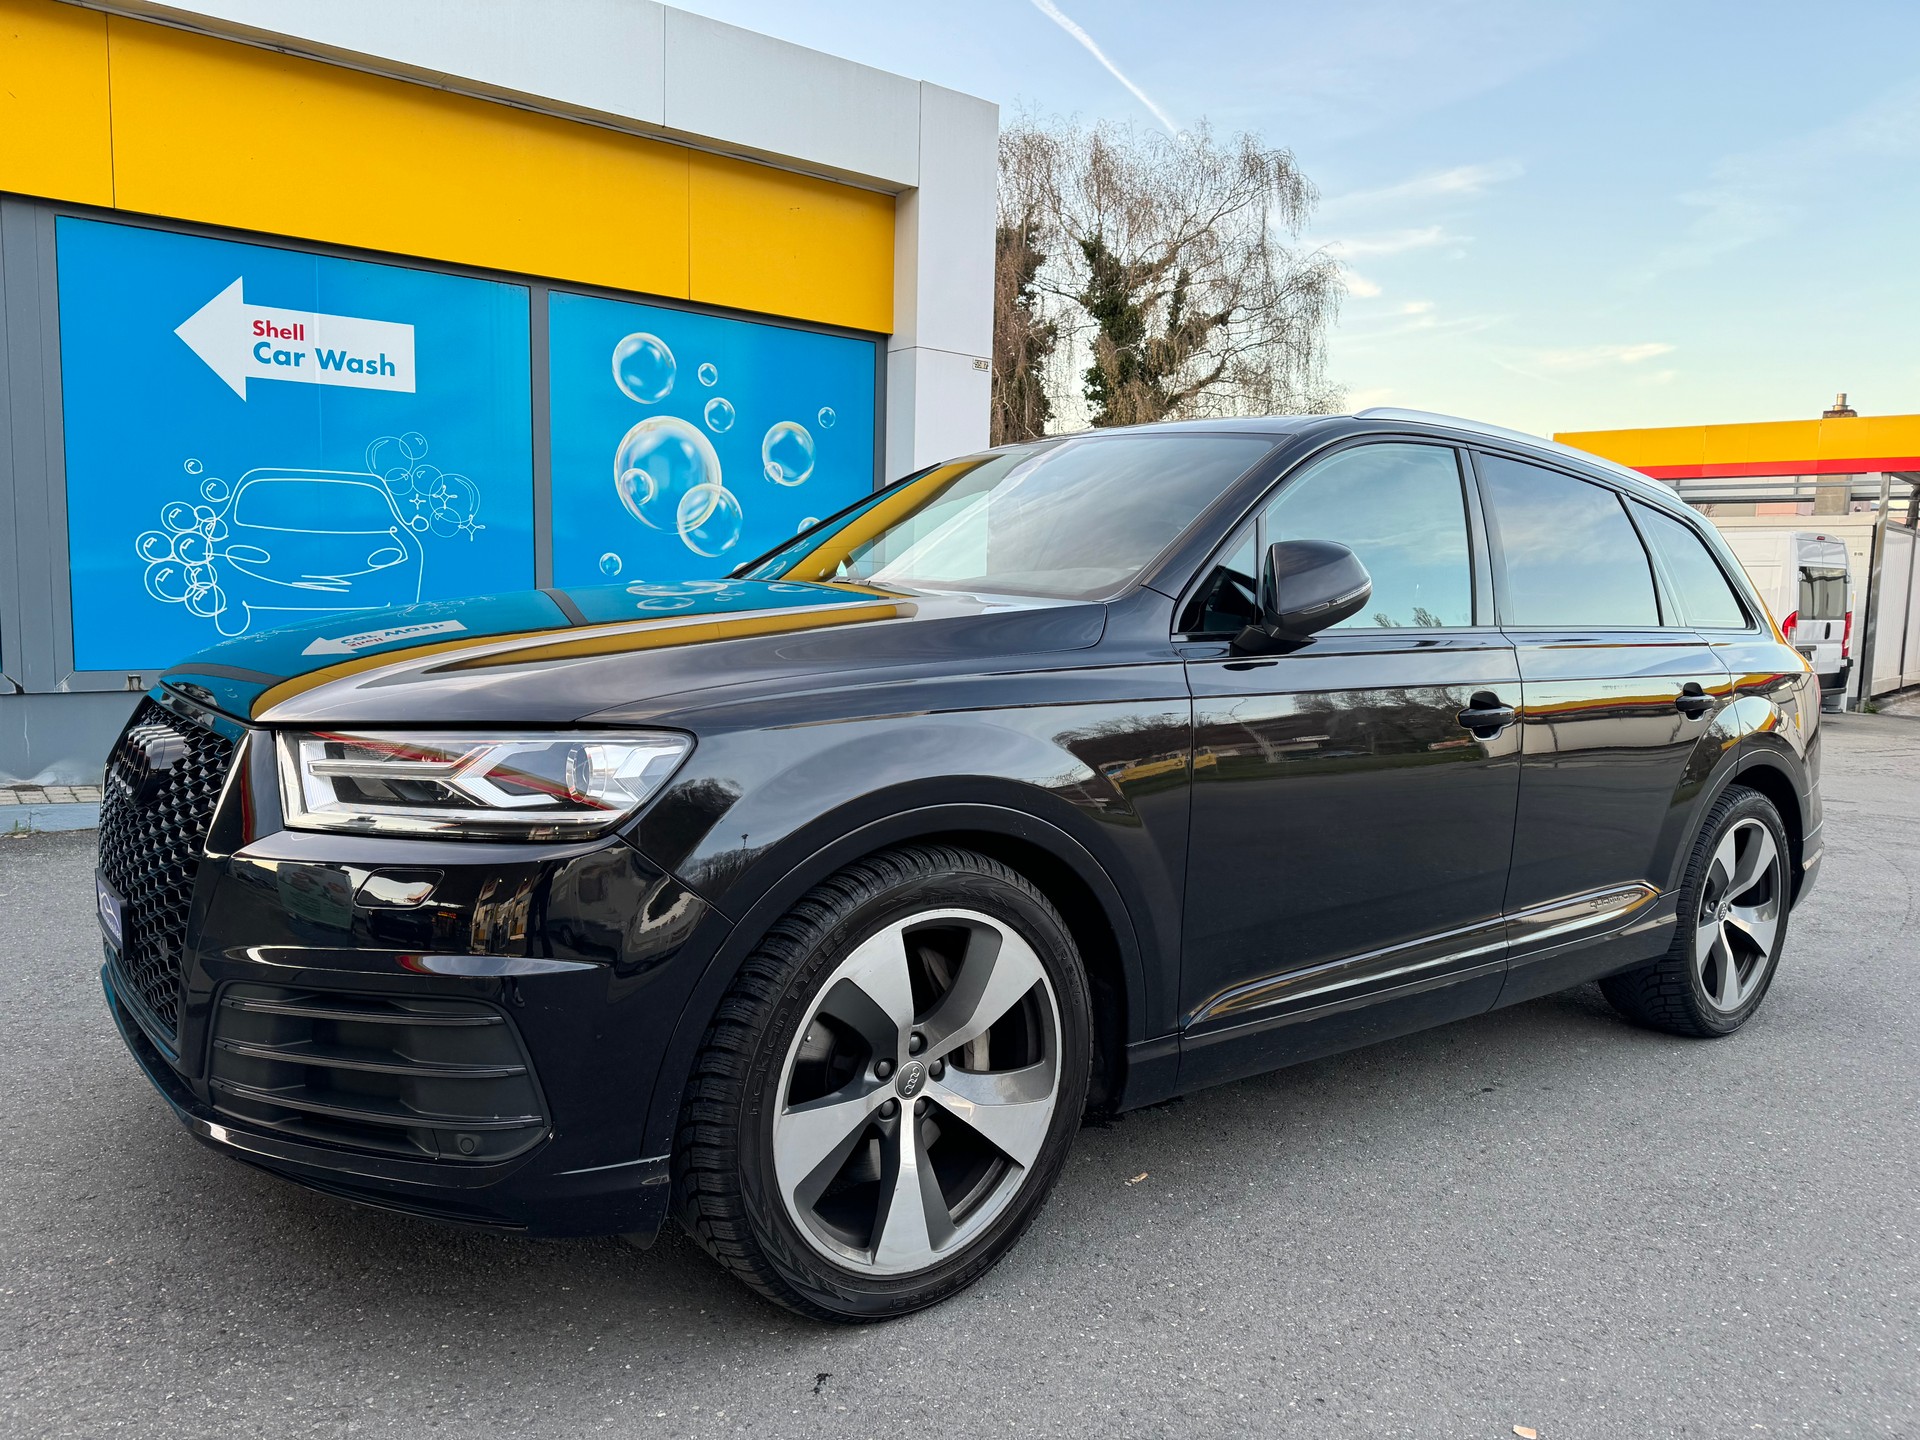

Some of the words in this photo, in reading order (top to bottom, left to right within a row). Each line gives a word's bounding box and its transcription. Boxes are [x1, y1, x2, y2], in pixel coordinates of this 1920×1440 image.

[252, 319, 305, 341] Shell
[252, 341, 306, 367] Car
[314, 347, 396, 377] Wash
